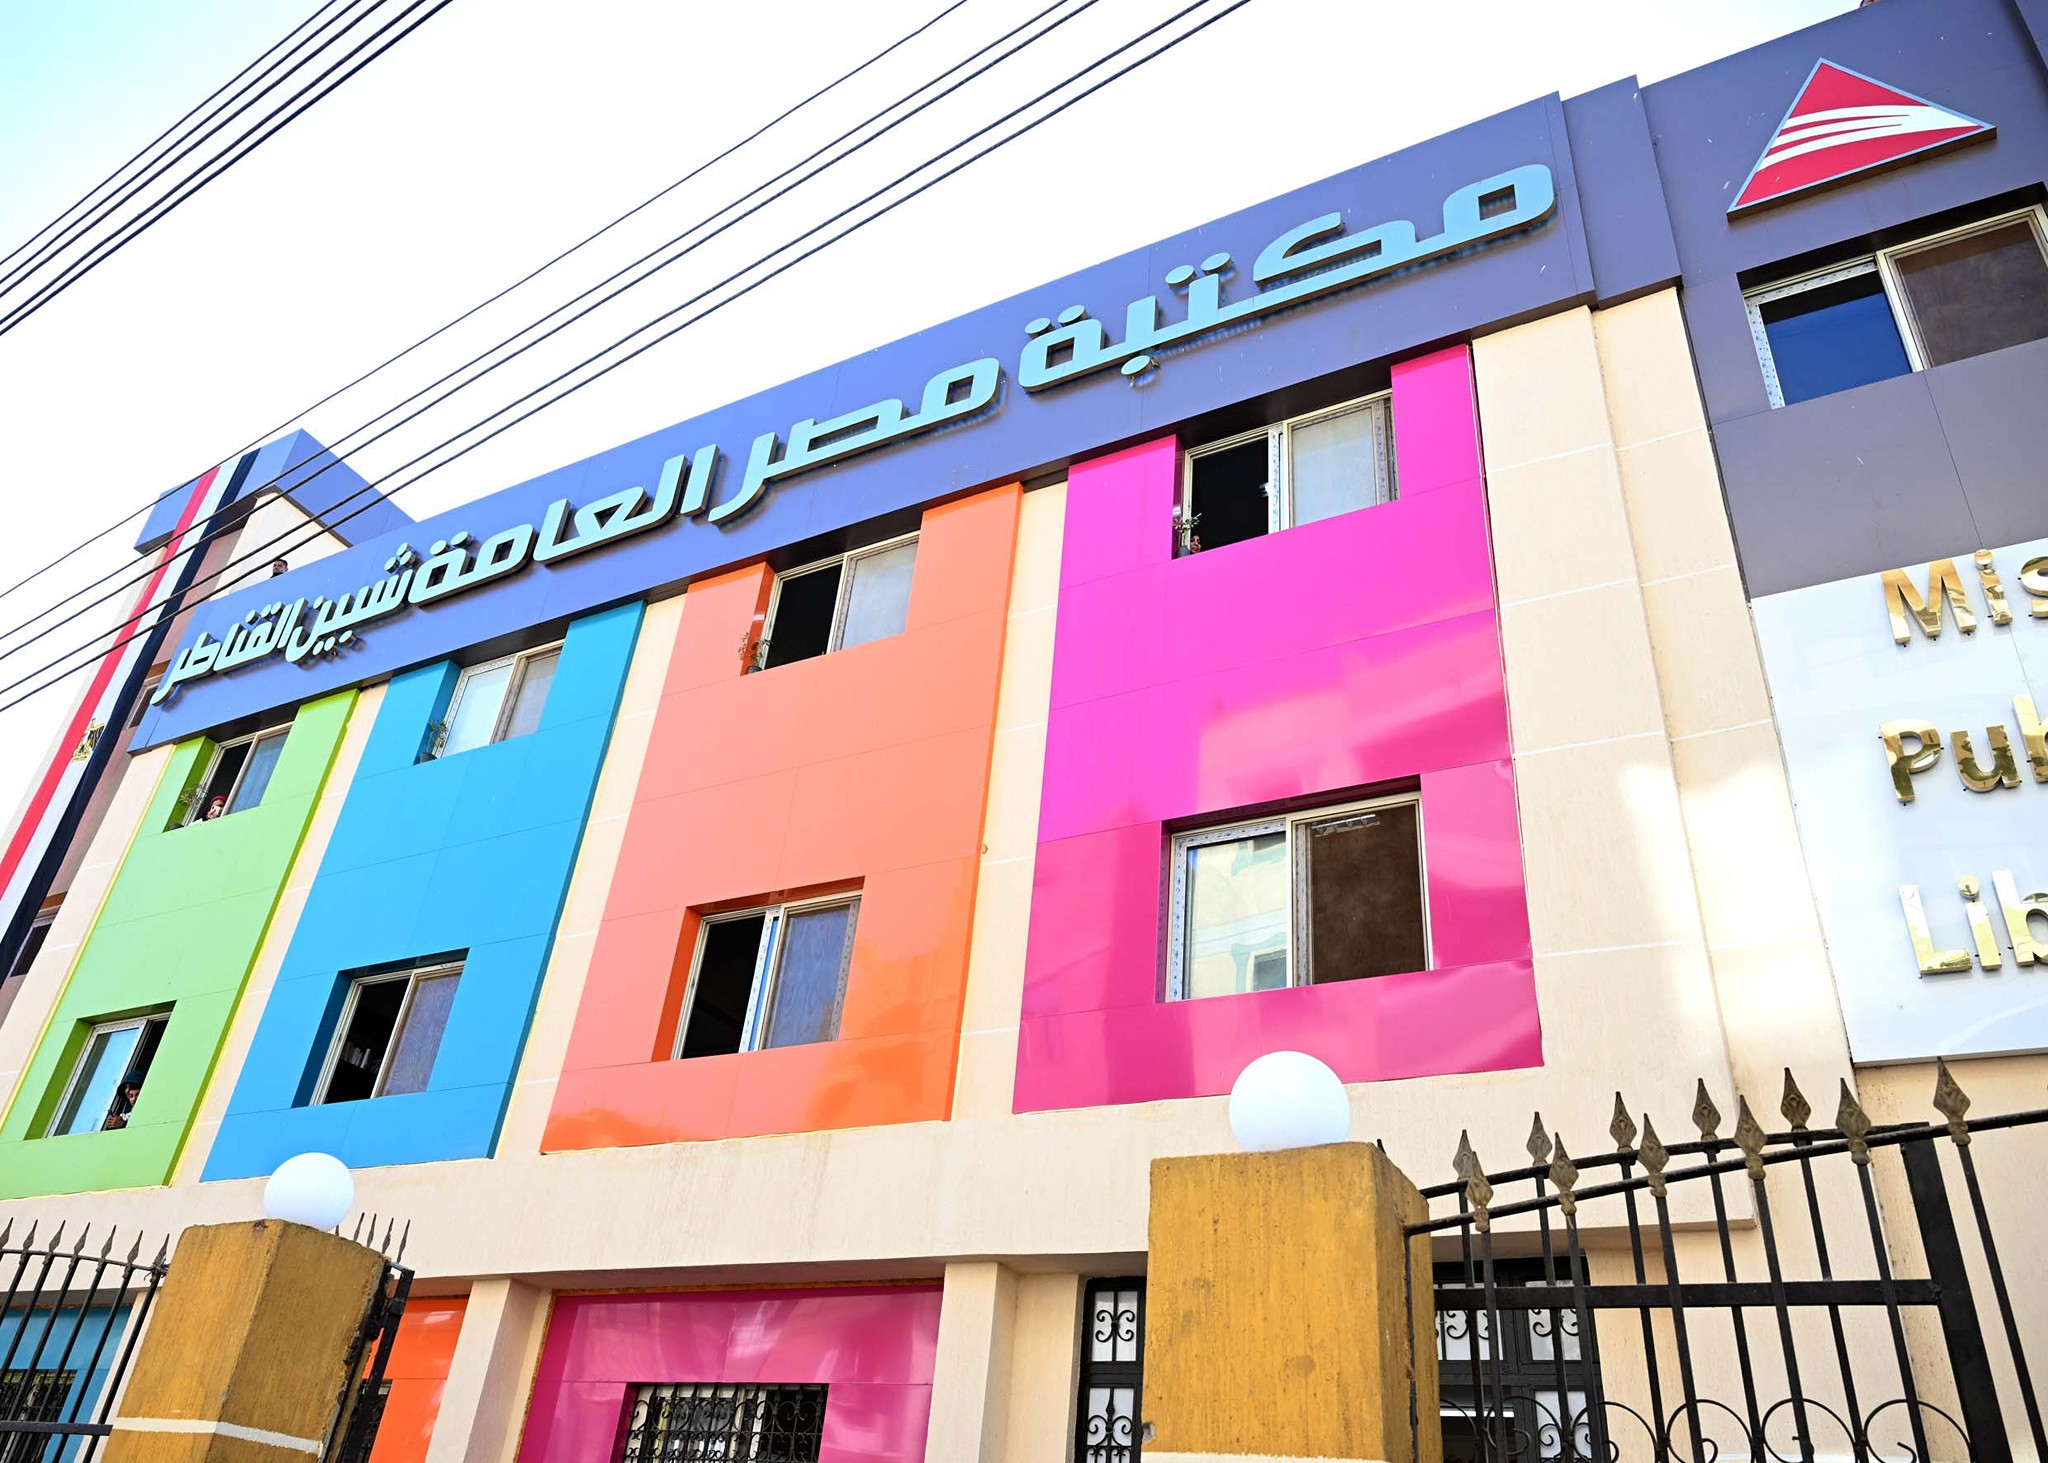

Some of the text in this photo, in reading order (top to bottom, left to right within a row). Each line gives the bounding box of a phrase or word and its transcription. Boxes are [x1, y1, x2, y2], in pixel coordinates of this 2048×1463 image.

[151, 164, 1556, 708] مكتبة مصر العامة شبين القناطر
[1899, 869, 2048, 975] Lib
